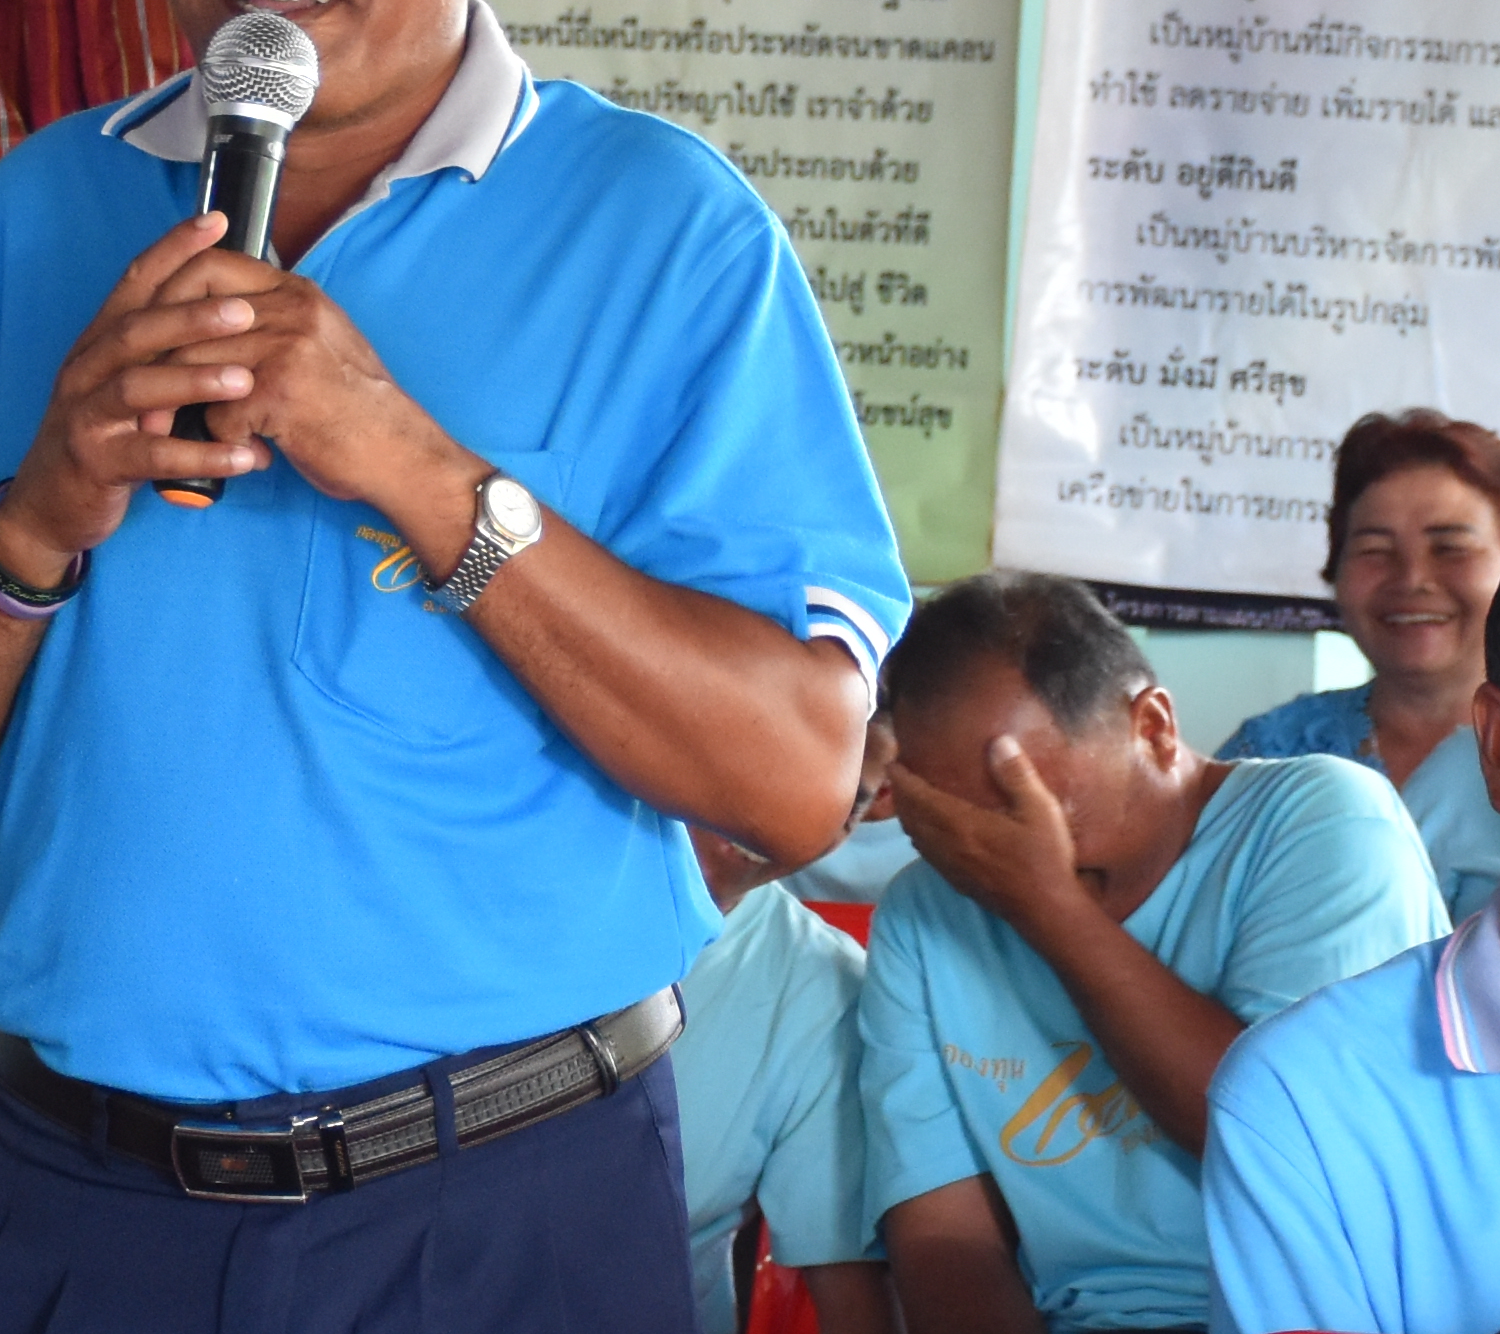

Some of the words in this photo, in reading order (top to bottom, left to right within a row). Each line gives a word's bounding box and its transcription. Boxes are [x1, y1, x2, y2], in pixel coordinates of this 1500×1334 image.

[1168, 75, 1312, 120] ลดรายจ่าย
[1087, 148, 1165, 188] ระดับ
[1175, 157, 1298, 201] อยู่ดีกินดี
[877, 271, 929, 307] ชีวิต
[1228, 357, 1308, 408] ศรีสุข
